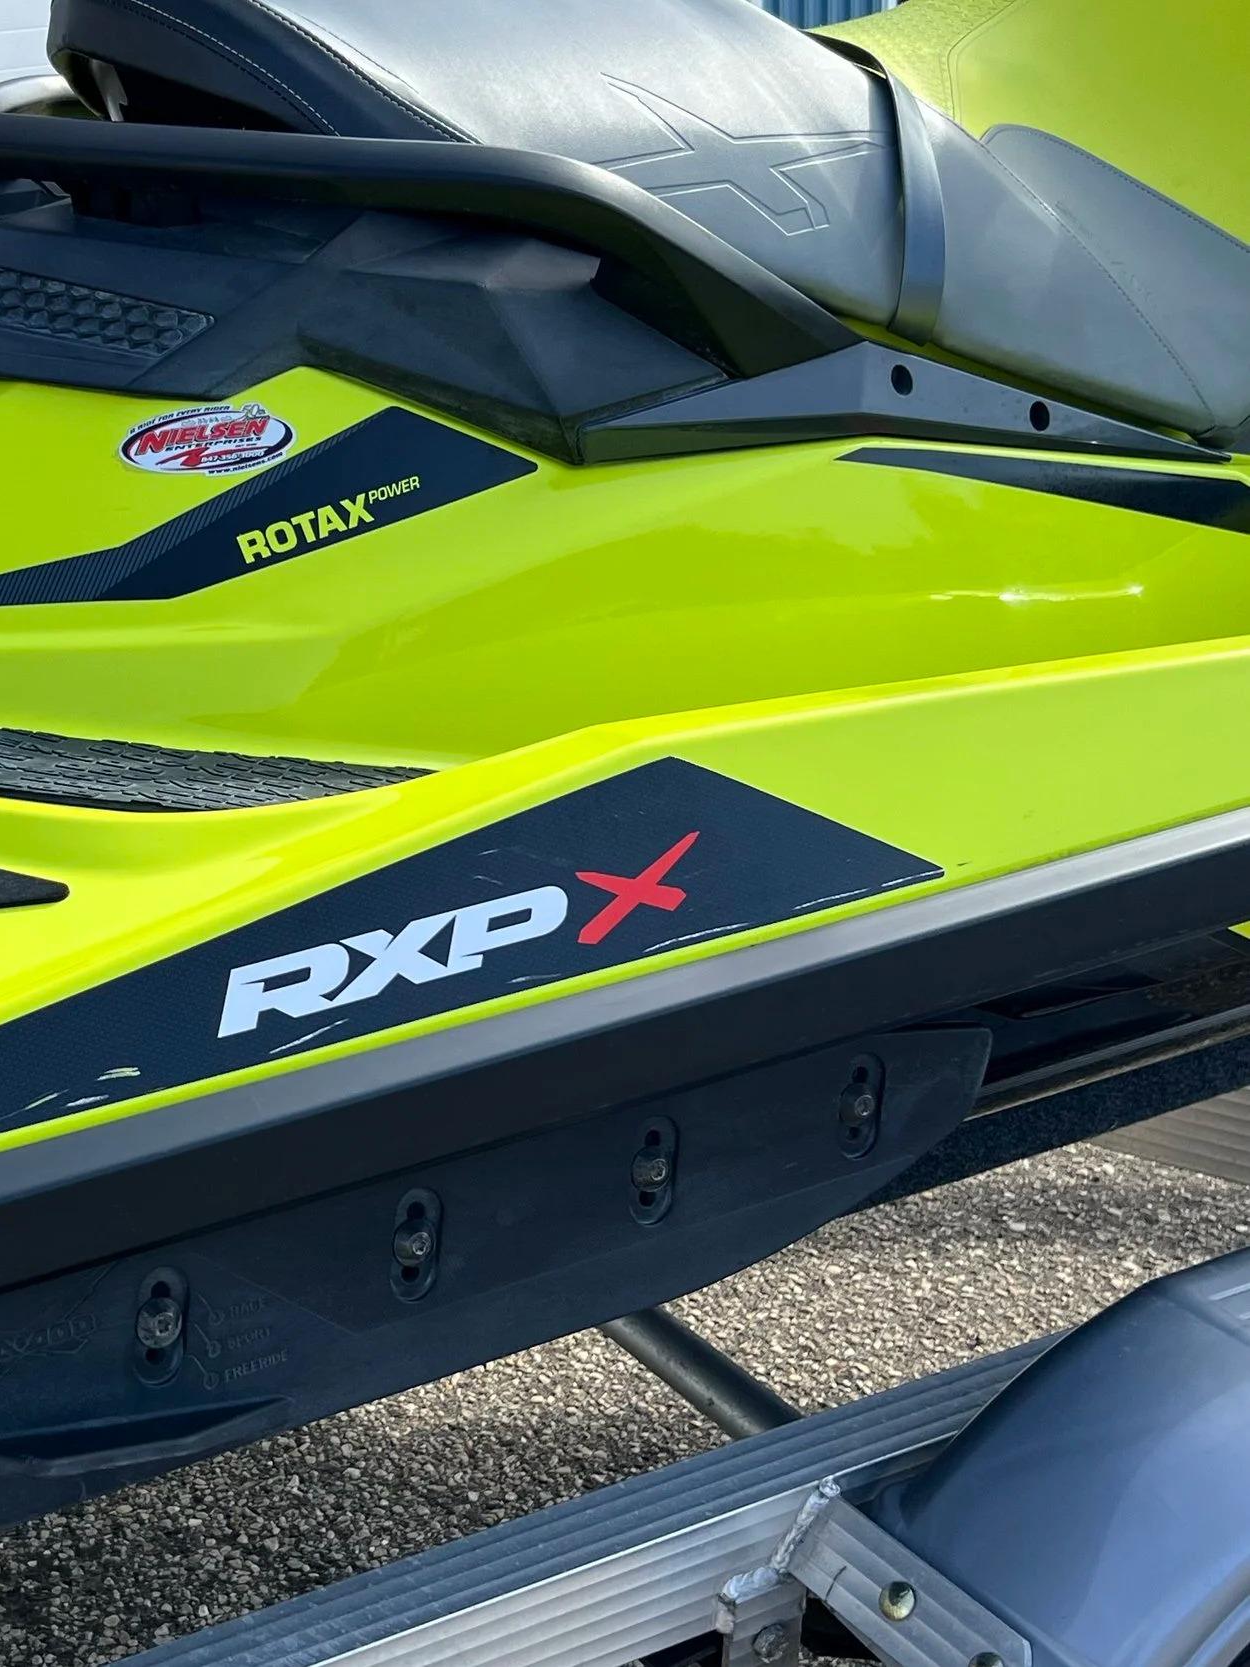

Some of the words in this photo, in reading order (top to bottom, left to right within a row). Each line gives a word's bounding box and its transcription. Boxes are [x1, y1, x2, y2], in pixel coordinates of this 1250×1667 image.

[135, 415, 270, 455] NIELSEN
[165, 436, 262, 452] ENTERPRISES
[236, 493, 375, 564] ROTAX
[368, 475, 420, 505] POWER
[224, 1347, 290, 1384] FREERIDE
